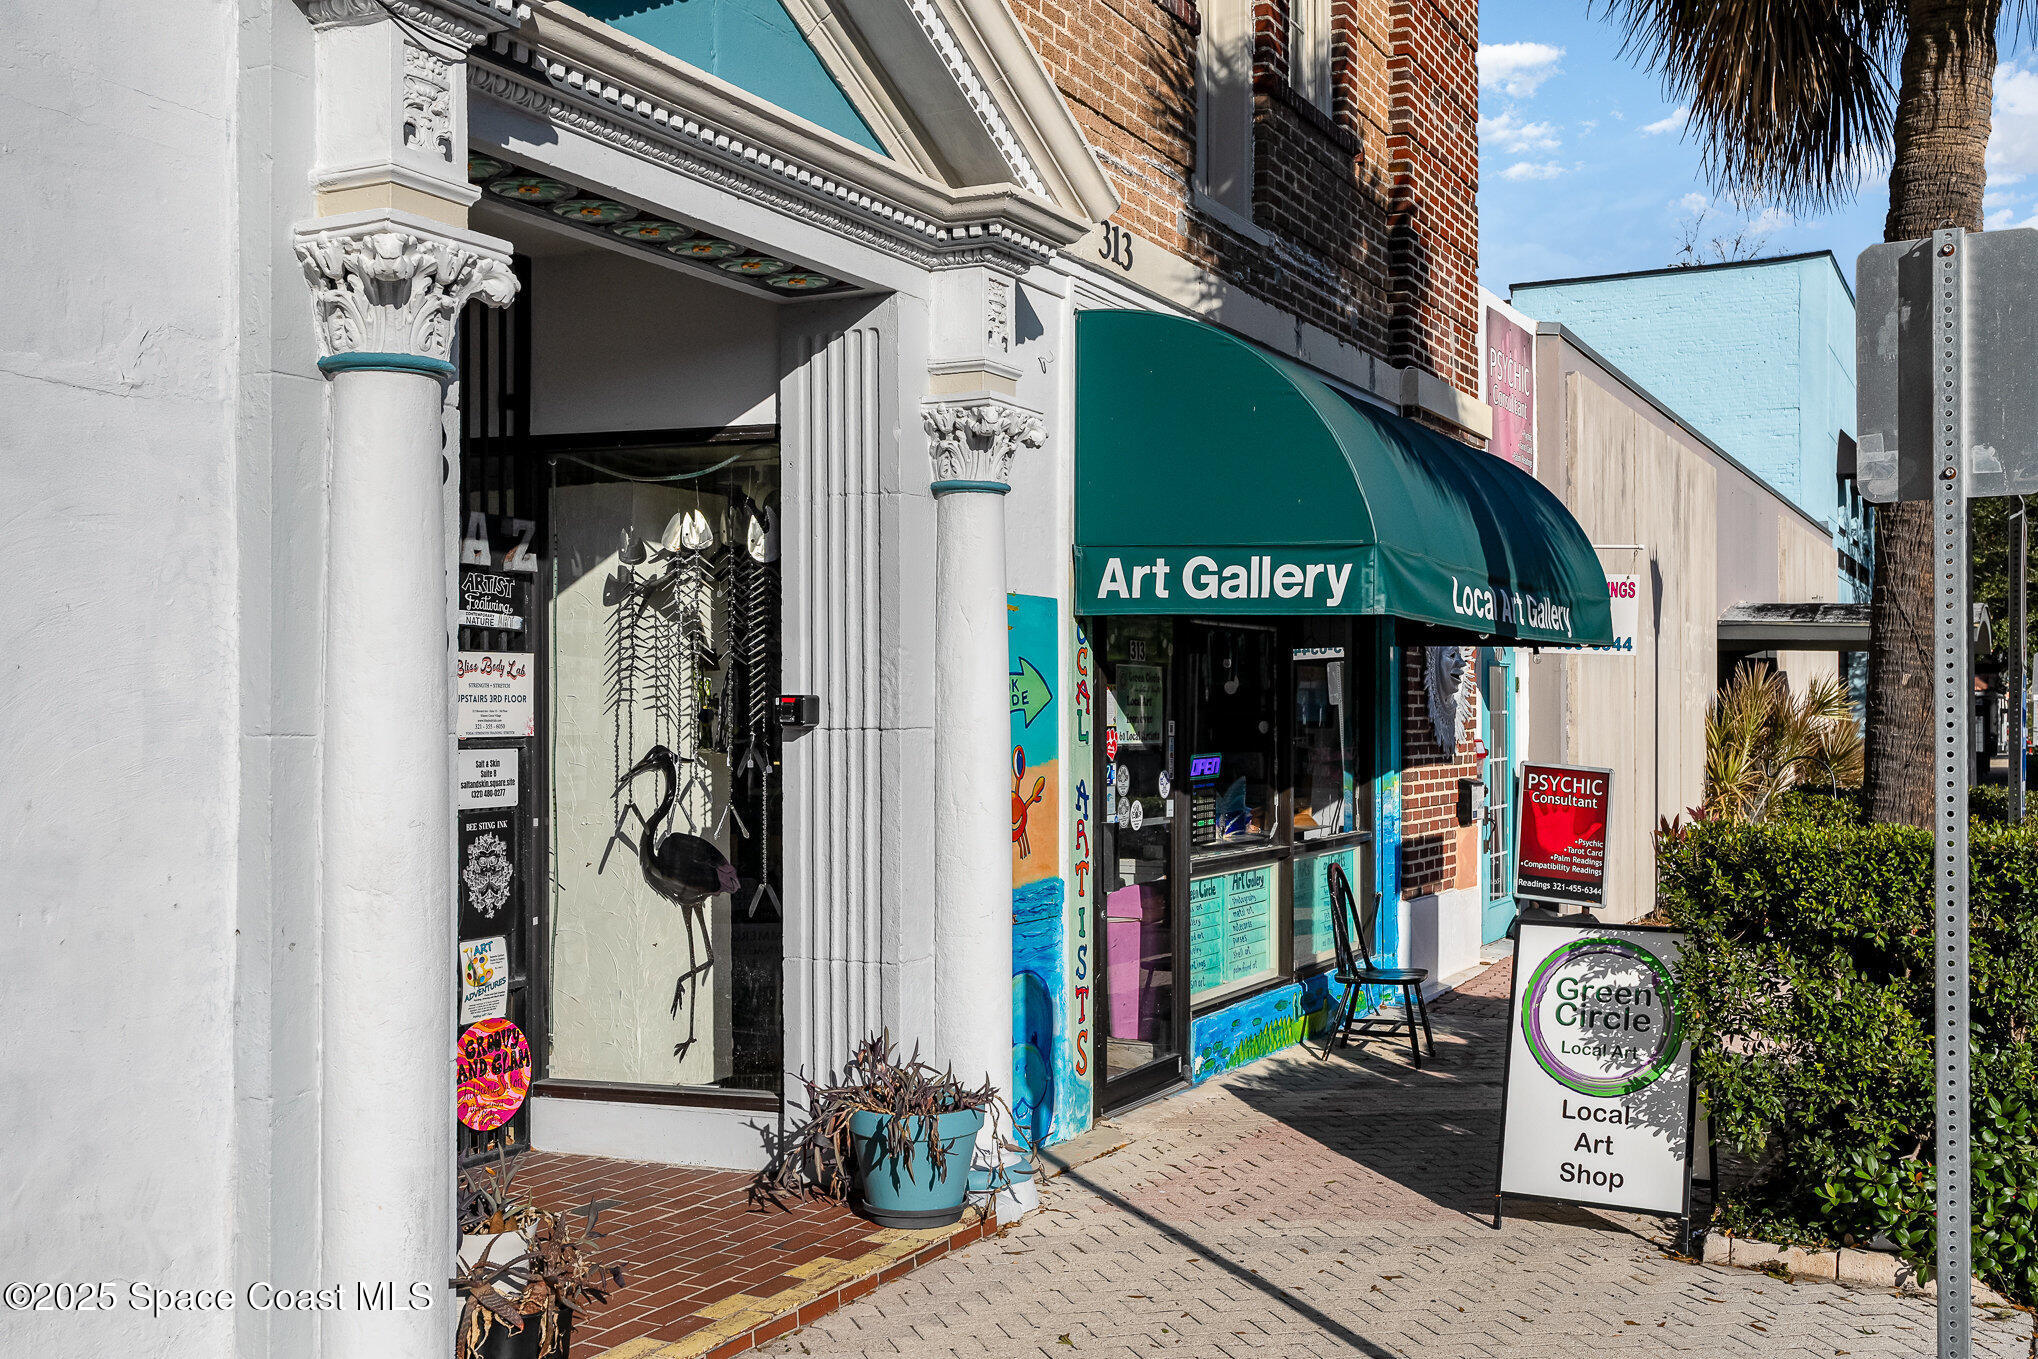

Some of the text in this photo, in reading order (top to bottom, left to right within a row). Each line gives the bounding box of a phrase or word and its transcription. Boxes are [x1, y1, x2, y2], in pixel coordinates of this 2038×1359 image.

[1099, 220, 1133, 271] 313
[1490, 347, 1530, 397] PSYCHIC
[1493, 384, 1528, 420] Consultant
[462, 572, 516, 599] ARTIST
[1098, 556, 1354, 608] Art Gallery
[465, 593, 513, 614] Featuring
[1452, 576, 1572, 638] Local Art Gallery
[465, 616, 495, 627] NATURE
[1130, 641, 1145, 660] 313
[457, 656, 527, 681] Bliss Body Lab
[489, 694, 503, 703] 3RD
[504, 694, 527, 703] FLOOR
[475, 760, 485, 769] Salt
[489, 759, 501, 768] Skin
[480, 769, 493, 778] Suite
[1190, 756, 1221, 777] OPEN
[460, 778, 516, 789] saltandskin.square.site
[1528, 773, 1603, 796] PSYCHIC
[1531, 791, 1598, 809] Consultant
[466, 820, 508, 832] BEE STING INK
[1075, 621, 1090, 1077] OCAL ARTISTS
[1586, 848, 1604, 857] Card
[1571, 865, 1602, 877] Readings
[1572, 856, 1603, 868] Readings
[1232, 868, 1264, 891] Art Gallery
[1518, 878, 1602, 895] Readings 321-455-6344
[473, 941, 494, 956] ART
[1232, 935, 1248, 945] purses
[464, 976, 507, 1003] ADVENTURES
[1556, 977, 1651, 1007] Green
[1555, 1001, 1651, 1033] Circle
[465, 1027, 520, 1060] GROOVY
[1561, 1040, 1638, 1060] Local Art
[457, 1048, 531, 1084] AND GLAM
[1562, 1099, 1630, 1125] Local
[1574, 1132, 1614, 1155] Art
[1559, 1162, 1625, 1192] Shop
